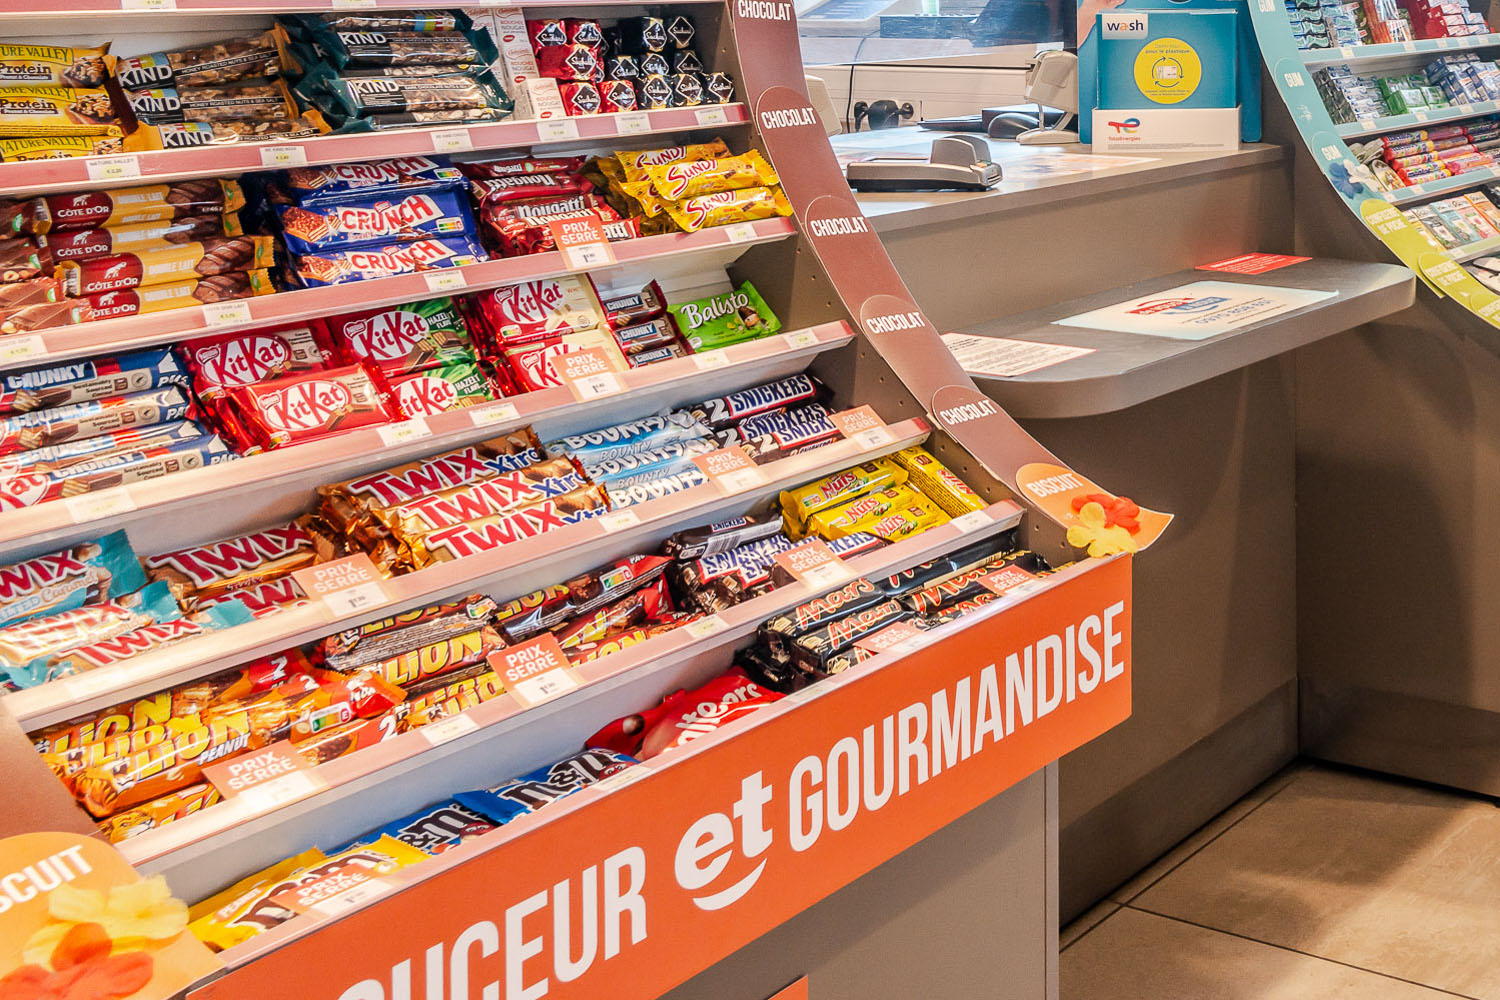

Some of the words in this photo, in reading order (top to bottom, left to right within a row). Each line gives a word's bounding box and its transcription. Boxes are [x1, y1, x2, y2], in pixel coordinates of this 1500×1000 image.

[1106, 19, 1145, 33] wash
[30, 47, 70, 63] VALLEY
[118, 63, 174, 90] KIND
[129, 96, 182, 116] KIND
[45, 136, 87, 151] VALLEY
[57, 206, 82, 219] CÔTE
[83, 204, 110, 217] D'OR
[343, 194, 436, 233] CRUNCH
[516, 196, 586, 220] Nougatti
[809, 216, 870, 238] CHOCOLAT
[86, 279, 113, 293] CÔTE
[114, 276, 139, 290] D'OR
[508, 281, 563, 324] KitKat
[605, 294, 642, 313] CHUNKY
[681, 292, 749, 330] Balisto
[865, 311, 926, 335] CHOCOLAT
[7, 361, 88, 391] CHUNKY
[211, 338, 286, 387] KitKat
[275, 384, 345, 432] KitKat
[732, 379, 814, 420] SNICKERS
[939, 398, 998, 426] CHOCOLAT
[566, 415, 668, 451] BOUNTY
[589, 443, 686, 479] BOUNTY
[413, 471, 536, 529] TWIX
[1026, 472, 1084, 499] BISCUIT
[712, 517, 747, 533] SNICKERS
[146, 522, 313, 589] TWIX
[313, 563, 354, 582] PRIX
[313, 567, 373, 594] SERRÉ
[795, 577, 875, 630] Mars
[58, 619, 203, 669] TWIX
[382, 630, 486, 685] LION
[505, 644, 541, 668] PRIX
[506, 652, 559, 682] SERRÉ
[132, 710, 252, 780] LION
[197, 733, 250, 766] PEANUT
[673, 768, 776, 893] et
[786, 599, 1126, 854] GOURMANDISE
